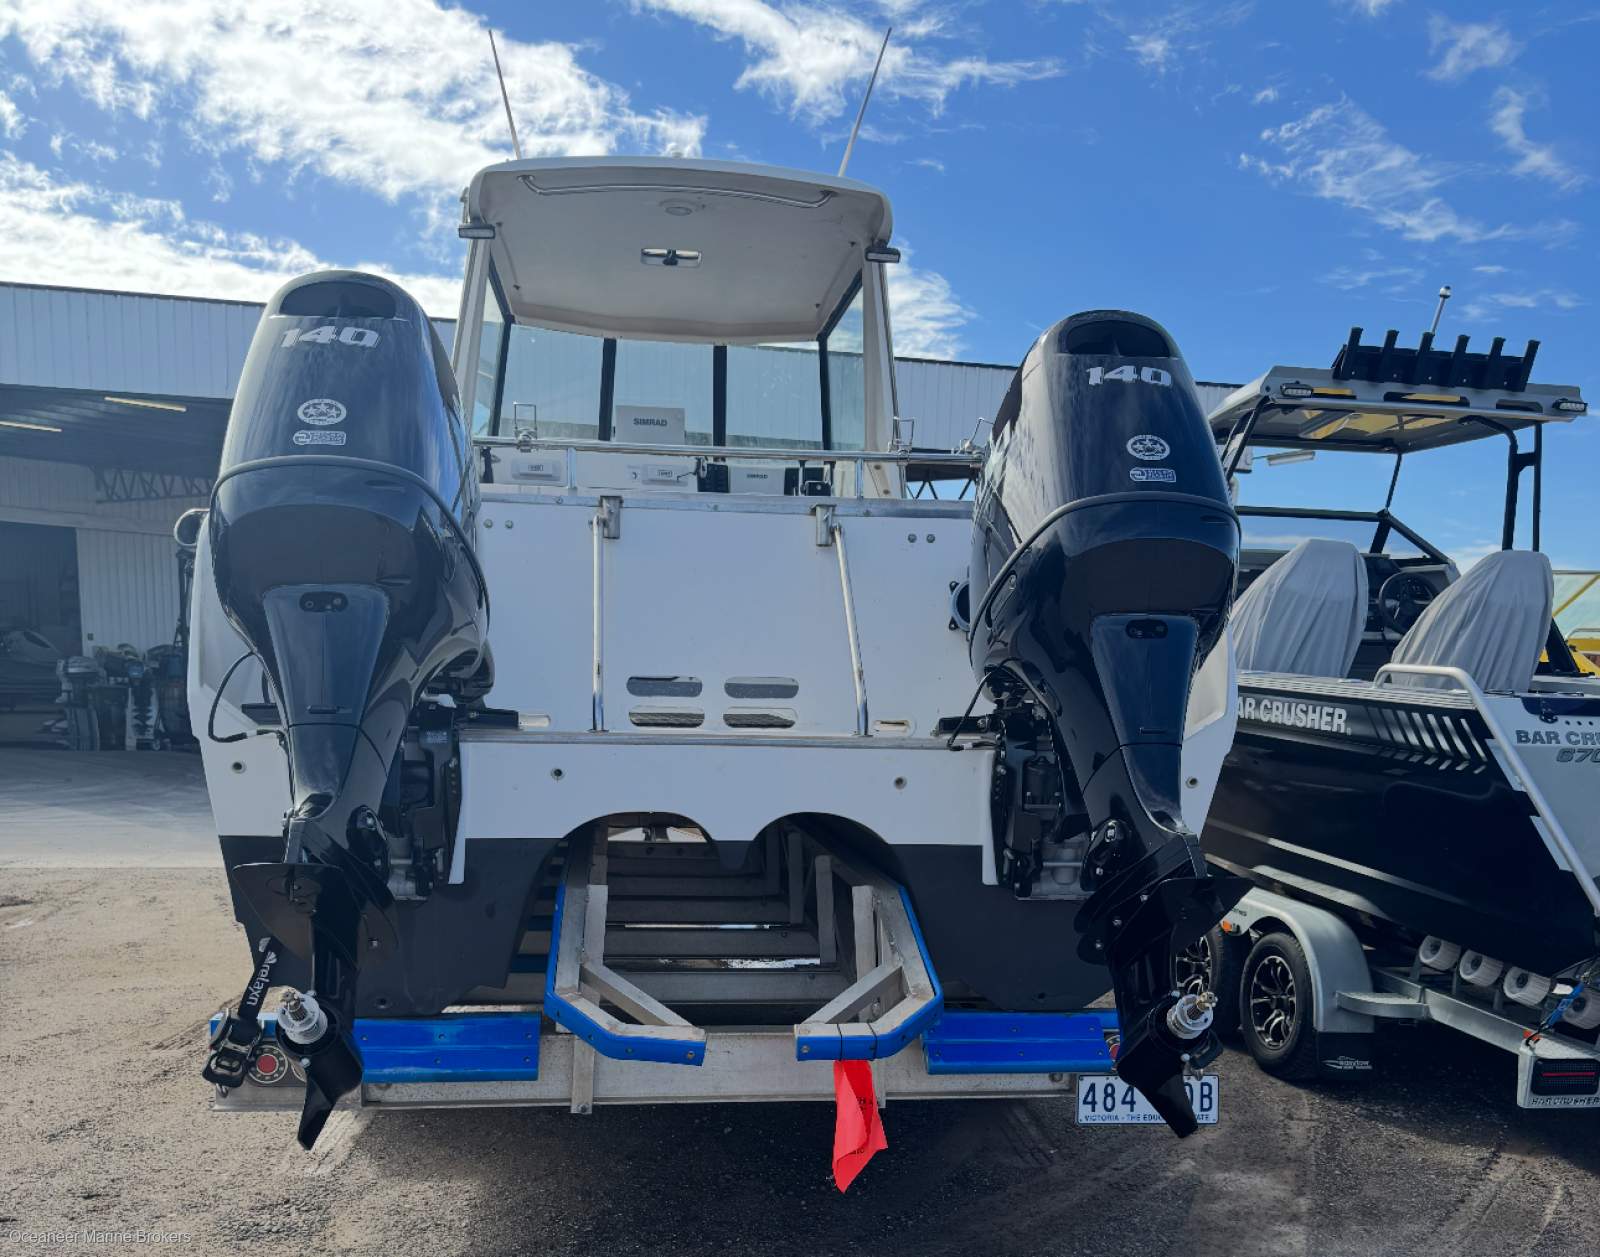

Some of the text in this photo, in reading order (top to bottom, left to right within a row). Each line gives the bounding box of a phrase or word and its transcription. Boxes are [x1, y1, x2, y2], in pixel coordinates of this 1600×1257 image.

[281, 326, 379, 348] 140
[1086, 365, 1172, 386] 140
[1260, 699, 1347, 734] CRUSHER
[1515, 730, 1560, 745] BAR
[1082, 1082, 1137, 1113] 484
